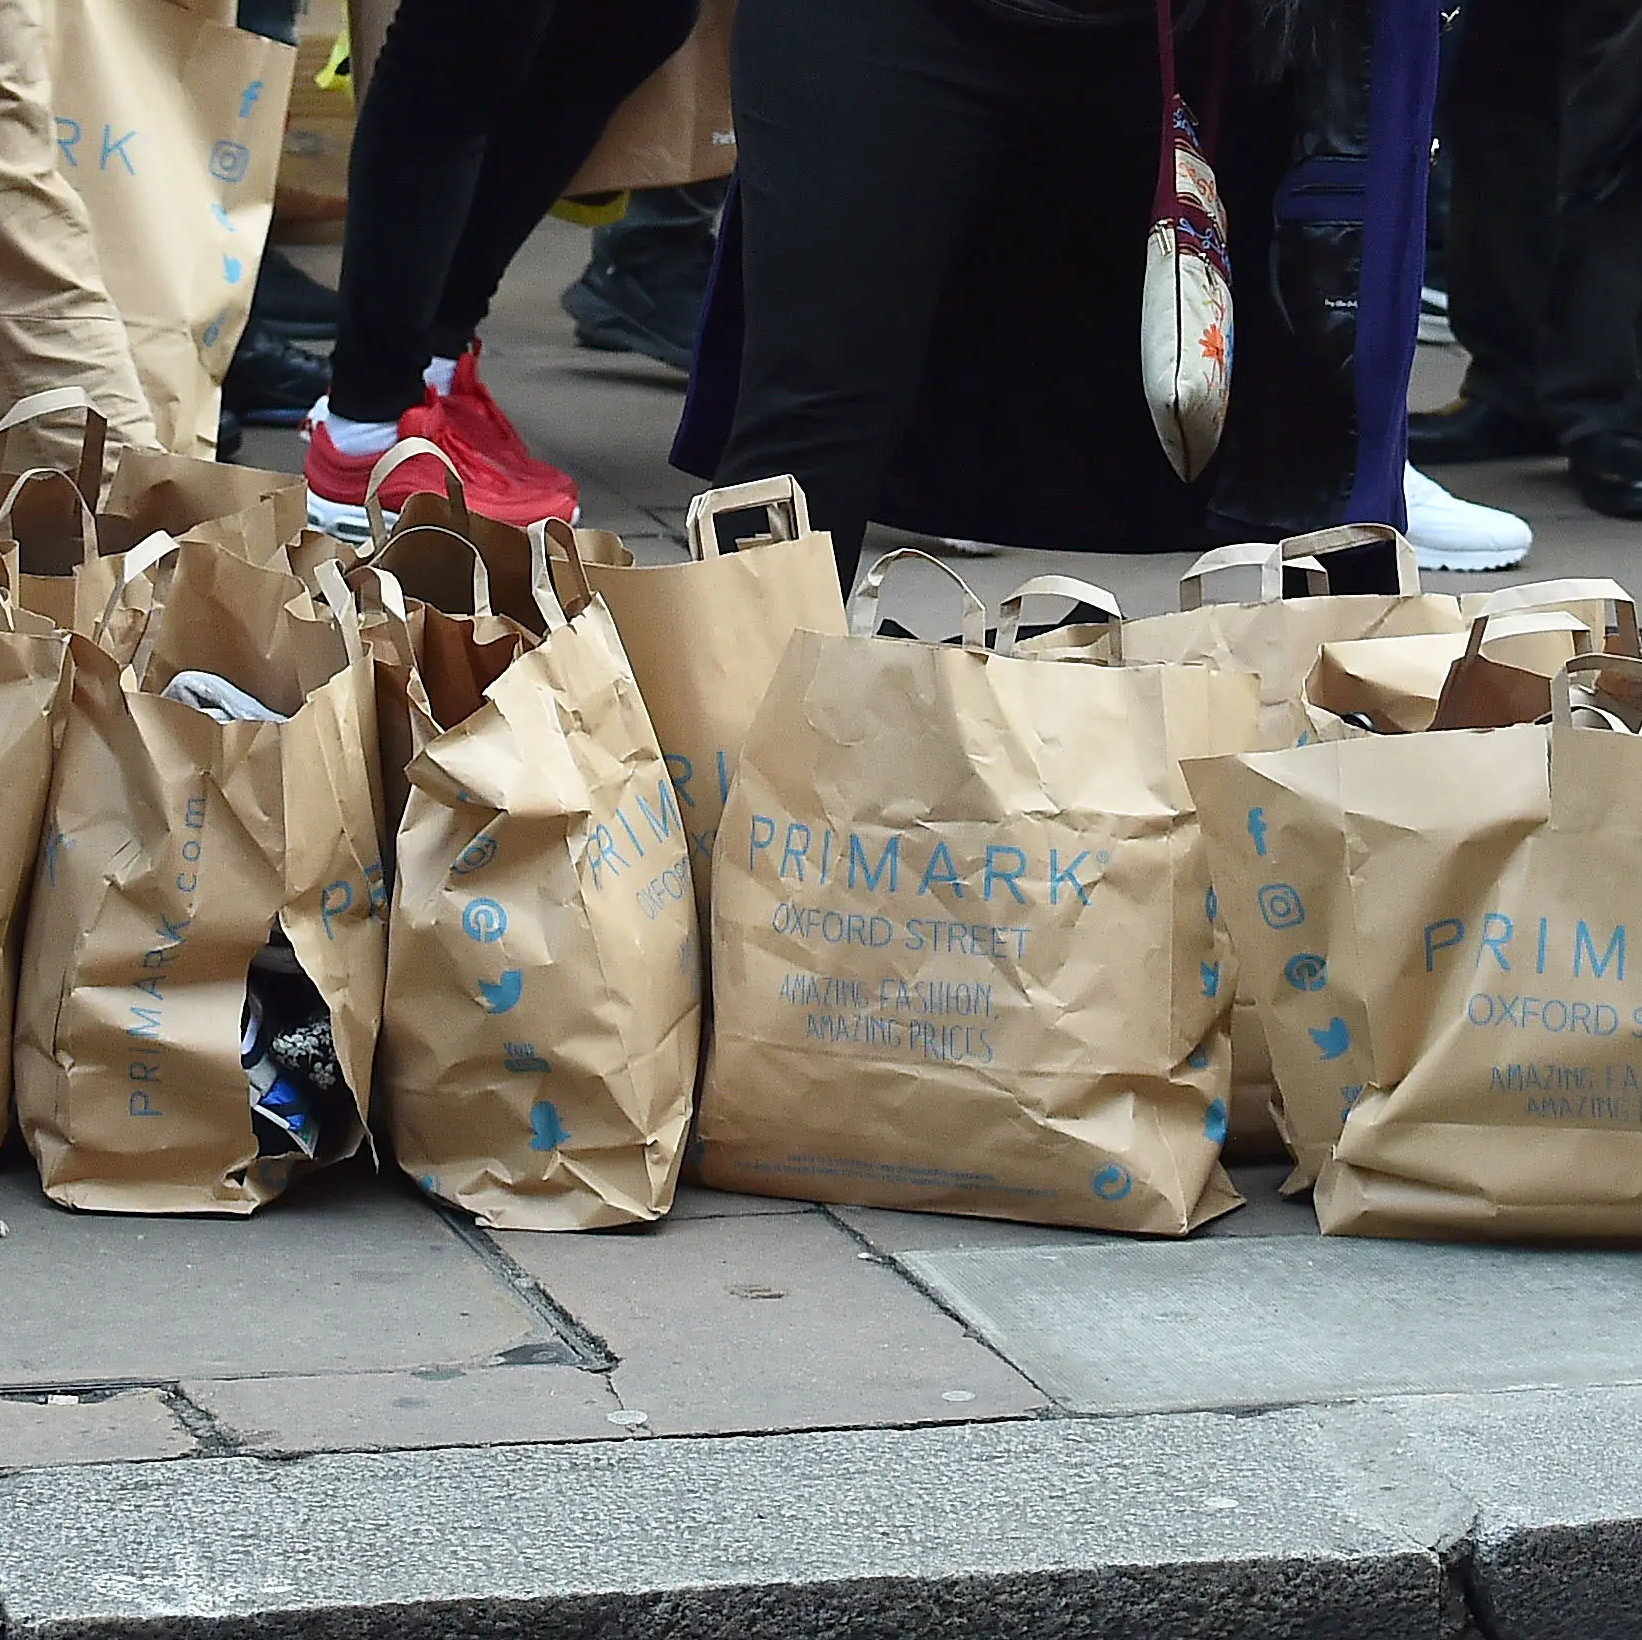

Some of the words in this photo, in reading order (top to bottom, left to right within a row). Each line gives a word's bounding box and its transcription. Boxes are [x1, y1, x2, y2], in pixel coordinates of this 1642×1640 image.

[750, 815, 1092, 906] PRIMARK
[772, 903, 894, 948] OXFORD
[905, 918, 1034, 960] STREET
[779, 973, 870, 1010] AMAZING
[1467, 992, 1620, 1036] OXFORD
[806, 1013, 901, 1049] AMAZING
[909, 1018, 994, 1064] PRICES
[1490, 1062, 1594, 1092] AMAZING
[1526, 1095, 1629, 1122] AMAZING
